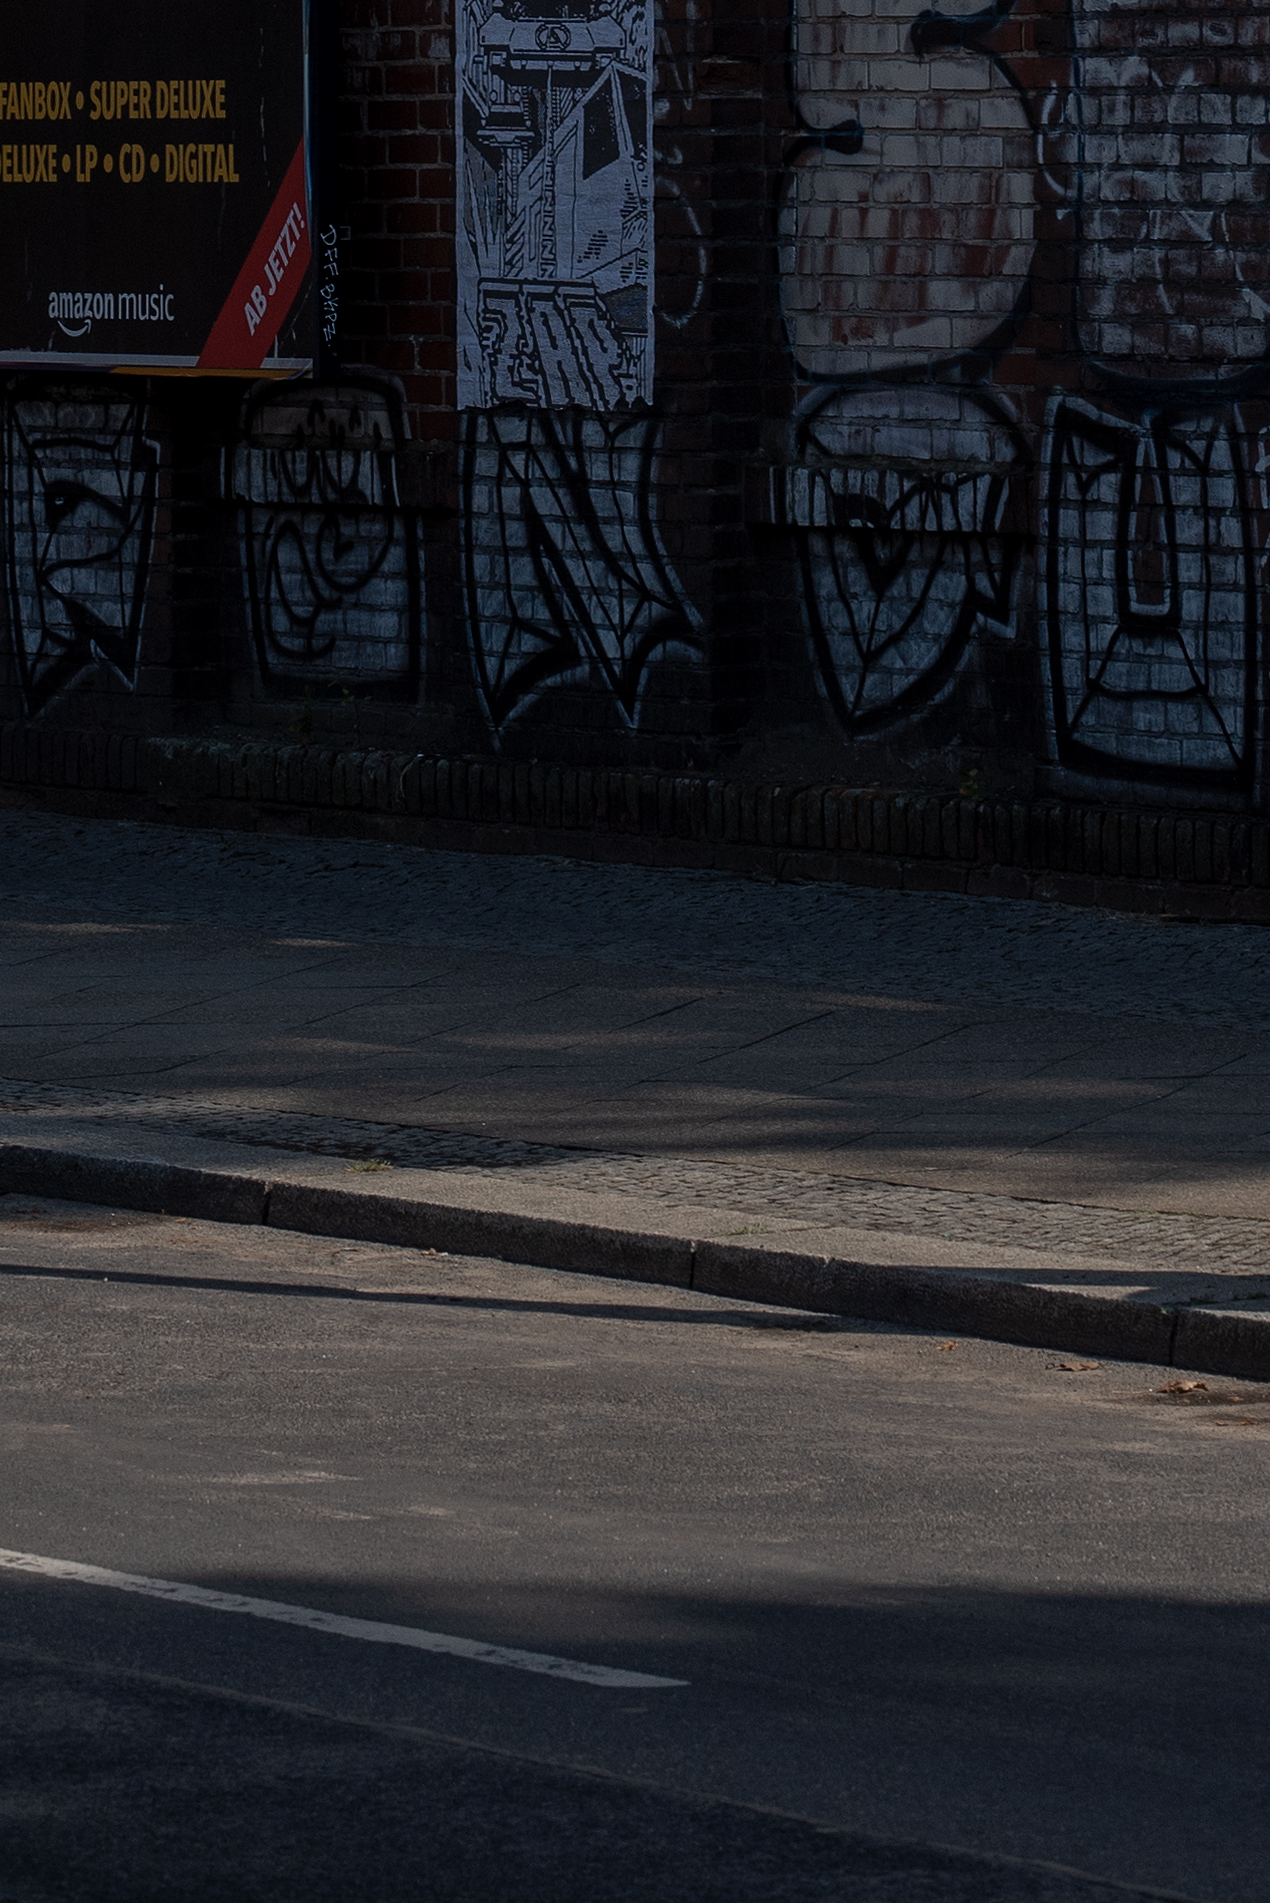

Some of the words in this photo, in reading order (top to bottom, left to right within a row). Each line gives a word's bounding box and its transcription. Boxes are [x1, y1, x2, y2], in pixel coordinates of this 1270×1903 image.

[89, 80, 153, 121] SUPER
[155, 79, 227, 120] DELUXE
[75, 143, 99, 183] LP
[118, 142, 146, 184] CD
[164, 142, 241, 184] DIGITAL
[243, 283, 269, 337] AB
[267, 201, 308, 296] JETZT!
[47, 290, 115, 321] amazon
[117, 283, 176, 322] music
